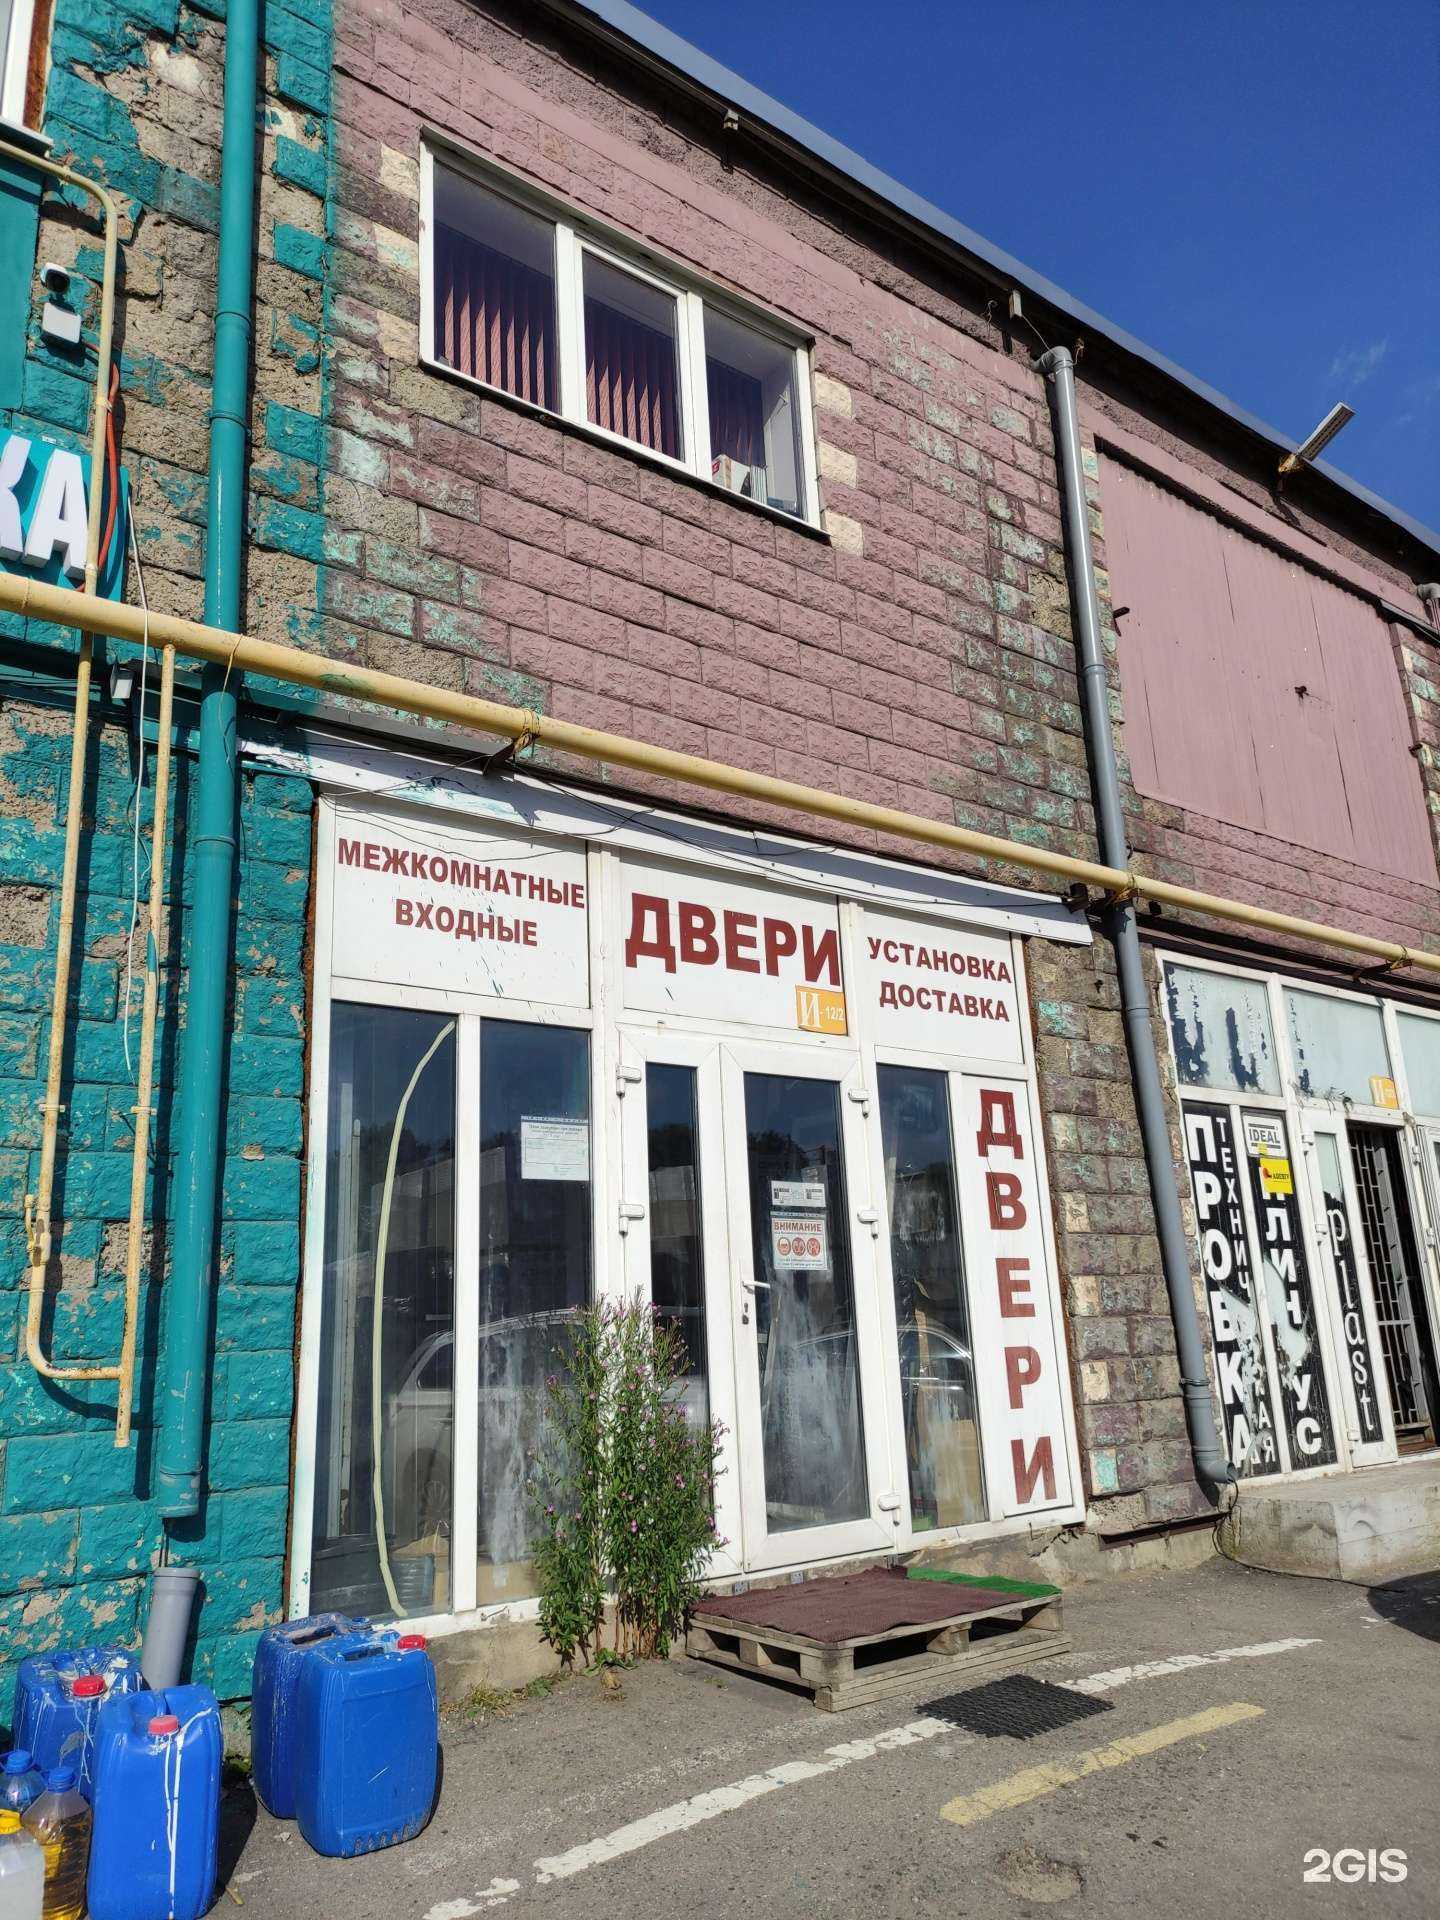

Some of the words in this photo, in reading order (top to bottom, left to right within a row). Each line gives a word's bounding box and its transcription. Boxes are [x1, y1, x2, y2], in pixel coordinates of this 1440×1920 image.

[338, 838, 585, 909] МЕЖКОМНАТНЫЕ
[395, 898, 538, 947] ВХОДНЫЕ
[625, 892, 841, 986] ДВЕРИ
[867, 936, 1012, 983] УСТАНОВКА
[879, 981, 1010, 1022] ДОСТАВКА
[1248, 1128, 1281, 1144] IDEAL
[774, 1221, 822, 1232] ВНИМАНИЕ
[976, 1089, 1058, 1505] ДВЕРИ
